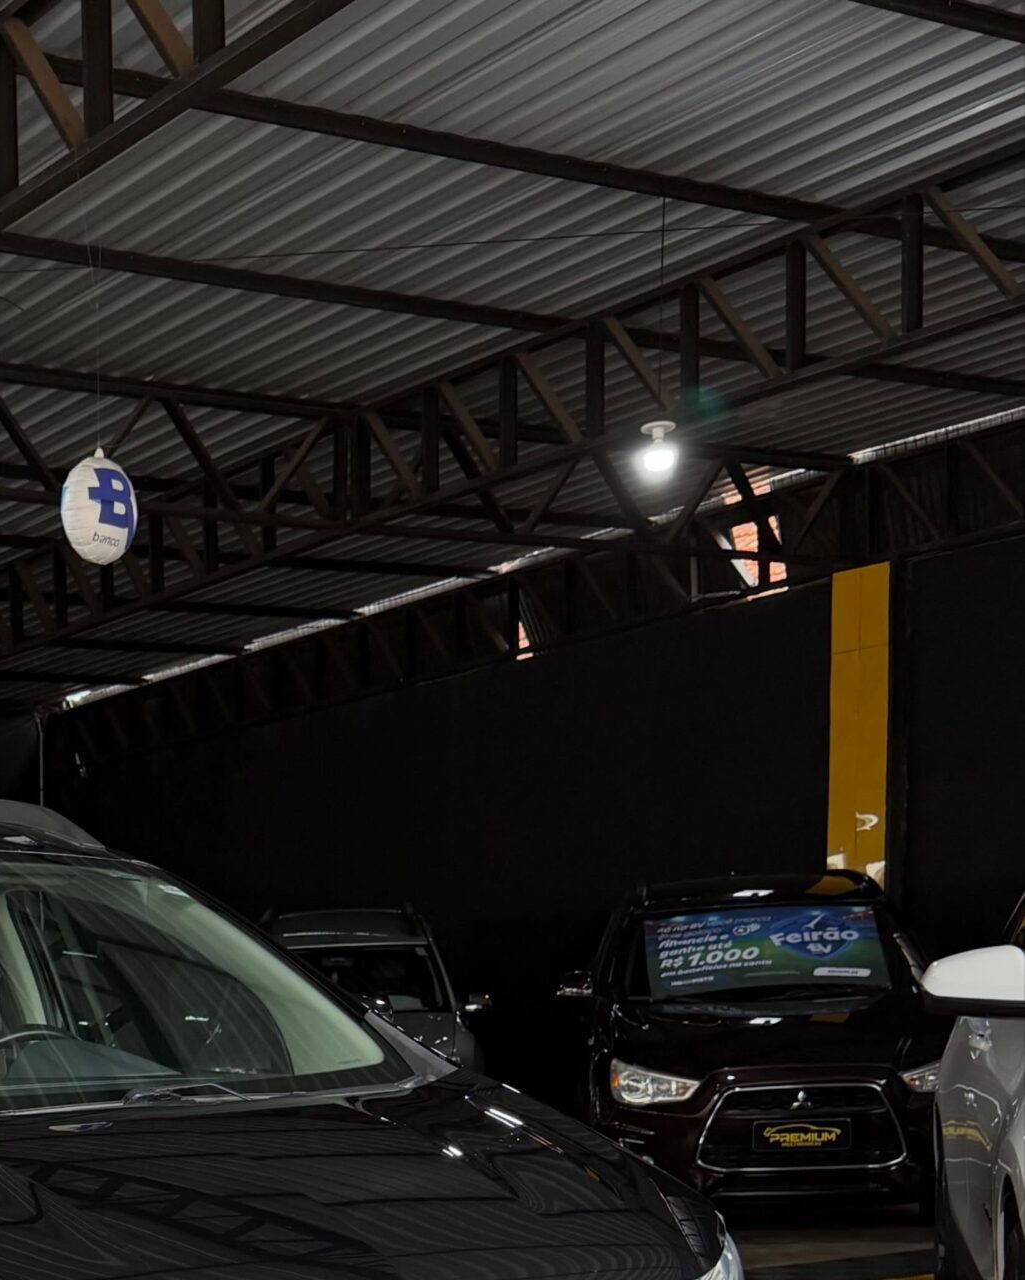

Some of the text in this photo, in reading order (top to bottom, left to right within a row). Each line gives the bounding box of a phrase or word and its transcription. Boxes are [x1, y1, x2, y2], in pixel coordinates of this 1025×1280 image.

[92, 531, 120, 548] banco
[769, 926, 860, 947] Feirão
[659, 946, 760, 969] R$ 1.000
[769, 1131, 836, 1144] PREMIUM
